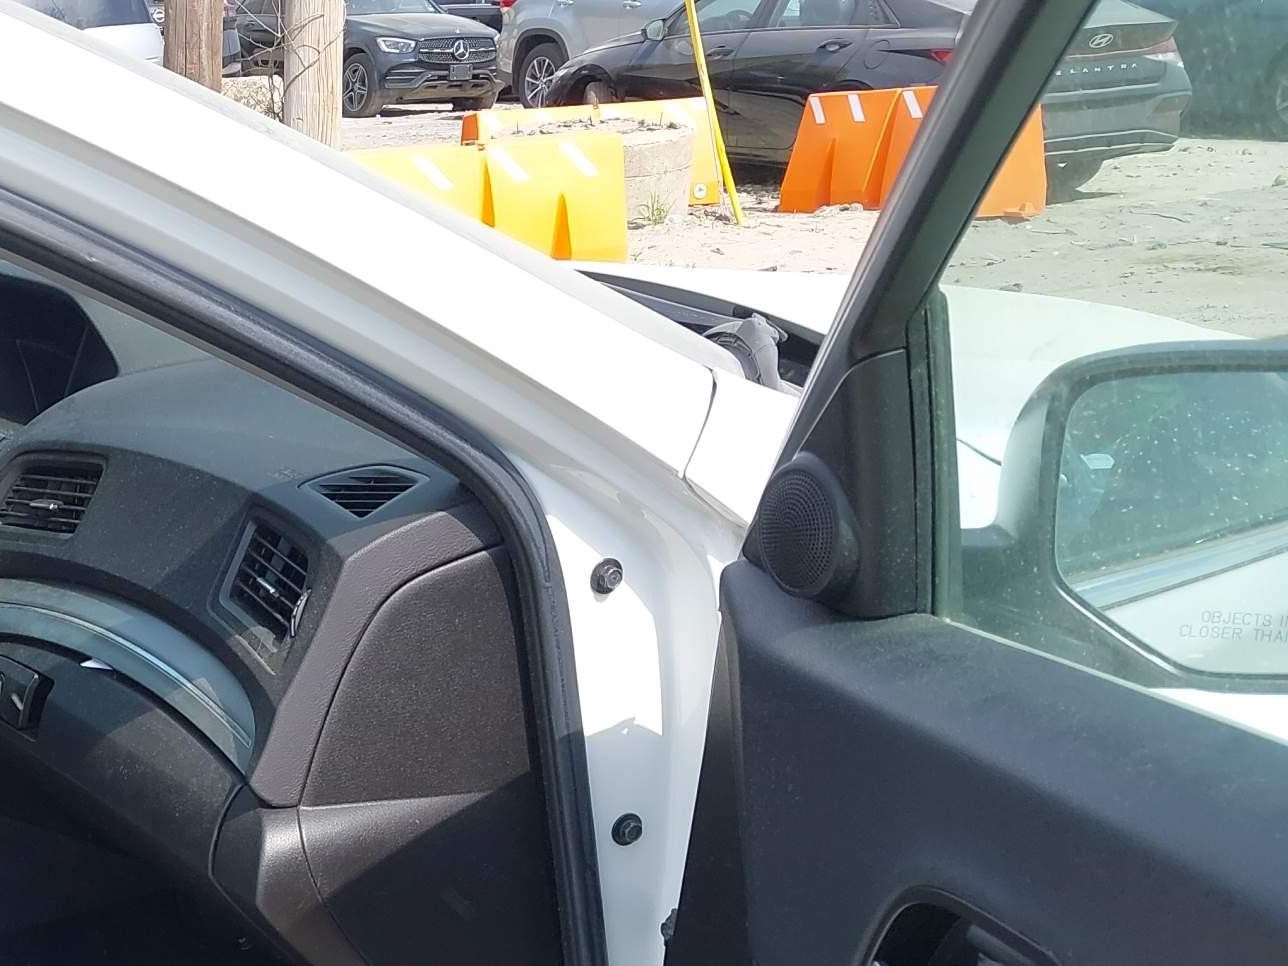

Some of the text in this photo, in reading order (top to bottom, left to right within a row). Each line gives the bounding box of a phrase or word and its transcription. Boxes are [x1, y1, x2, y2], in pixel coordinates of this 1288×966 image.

[1055, 63, 1137, 76] ELANTRA
[1200, 610, 1273, 627] OBJECTS
[1179, 623, 1288, 642] CLOSER THA
